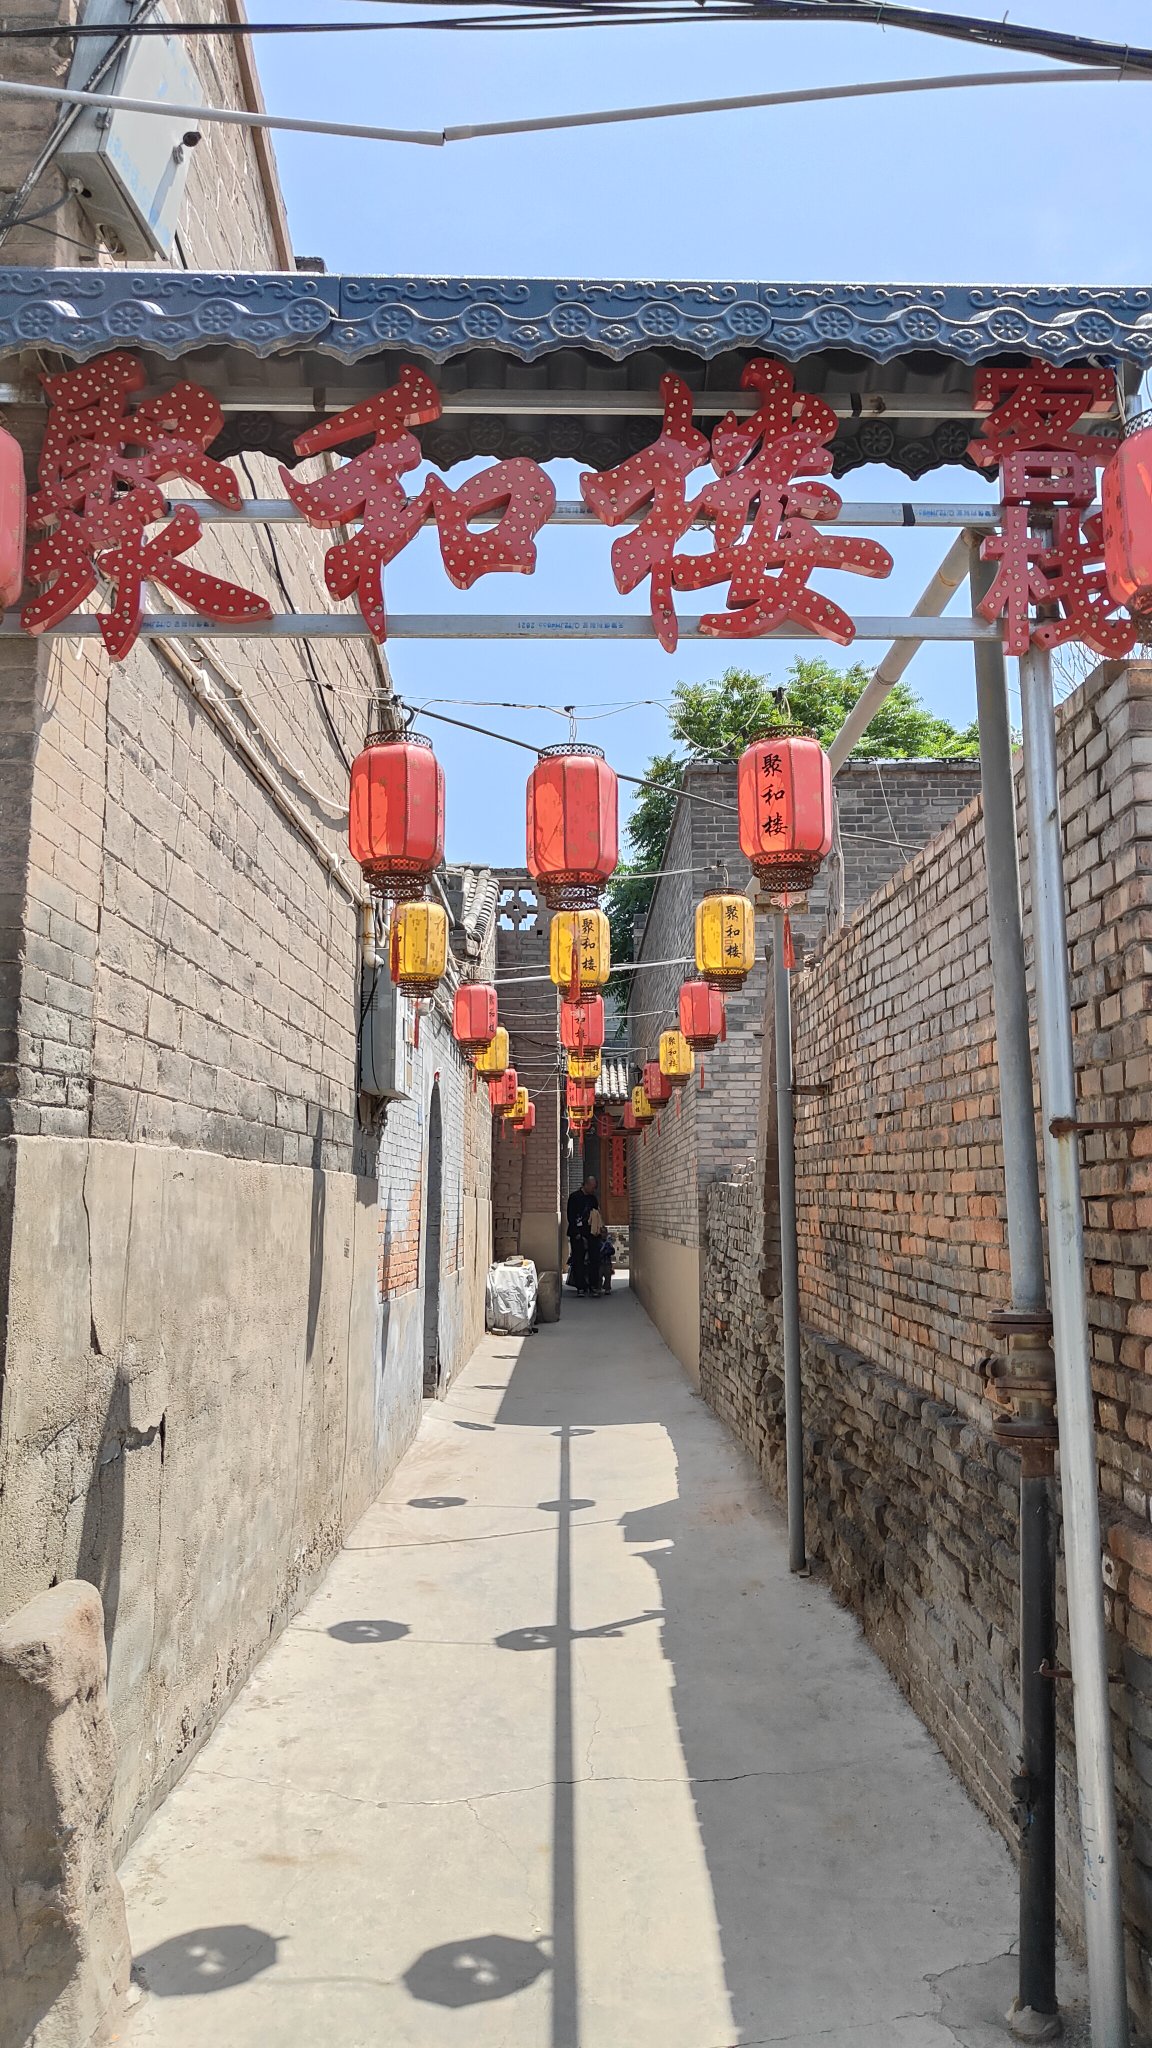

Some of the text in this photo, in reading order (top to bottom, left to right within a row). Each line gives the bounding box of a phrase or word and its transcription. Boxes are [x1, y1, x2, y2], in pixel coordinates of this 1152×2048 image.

[20, 352, 893, 662] 聚和楼
[968, 358, 1138, 660] 客栈
[761, 753, 788, 837] 聚和楼
[581, 918, 597, 972] 聚和楼
[725, 905, 742, 959] 聚和楼
[668, 1037, 677, 1067] 聚和楼
